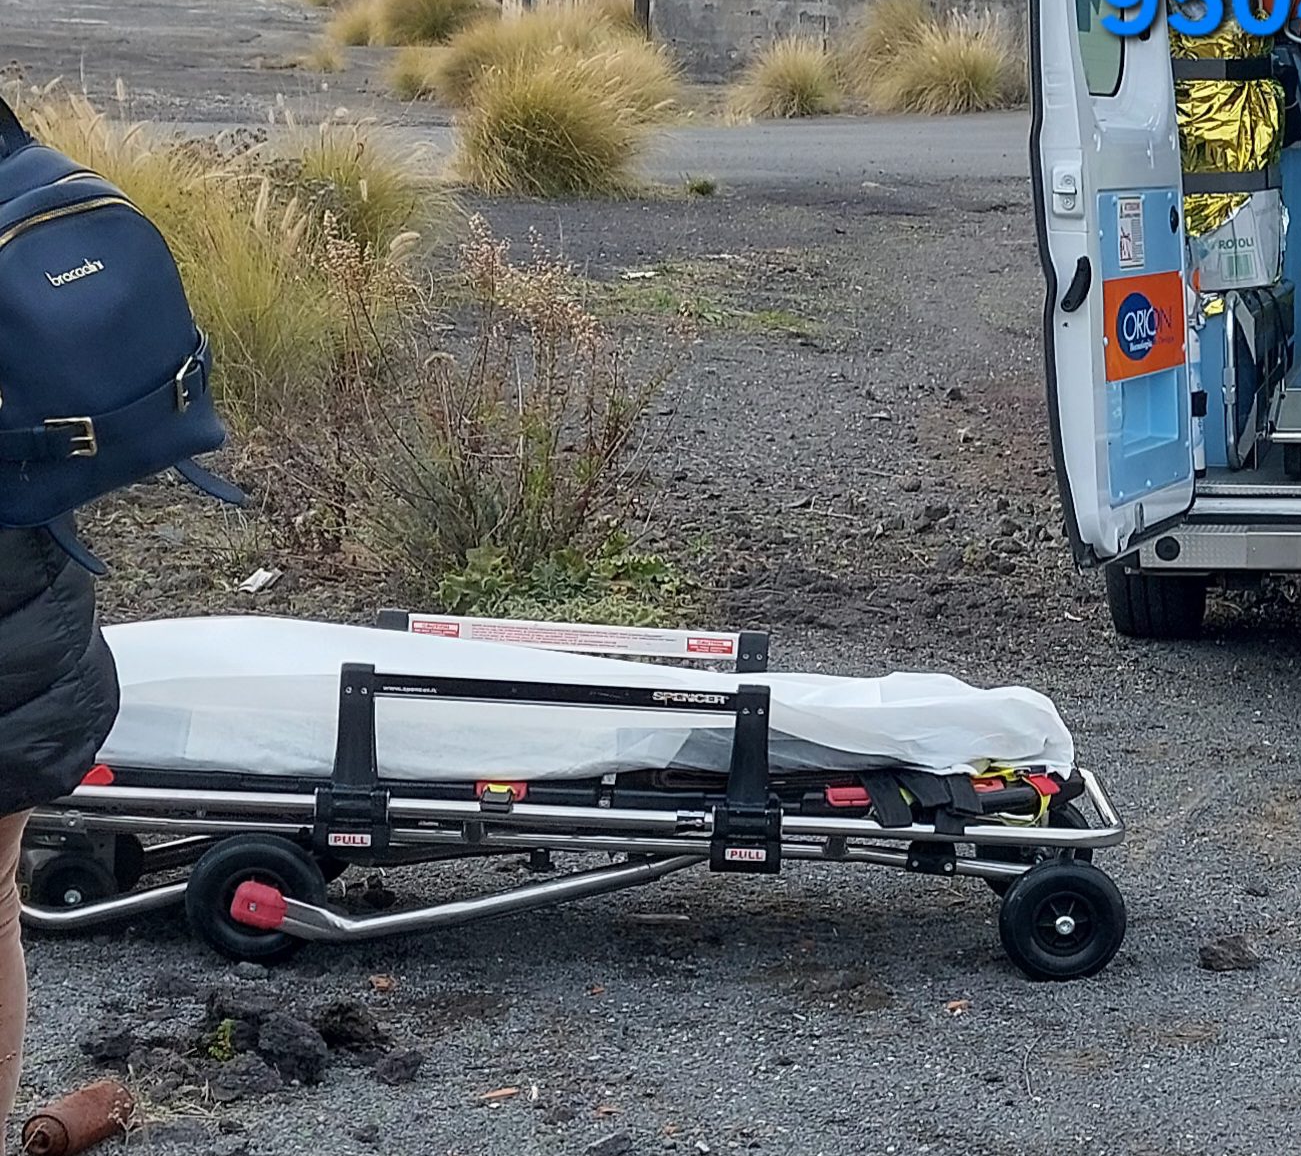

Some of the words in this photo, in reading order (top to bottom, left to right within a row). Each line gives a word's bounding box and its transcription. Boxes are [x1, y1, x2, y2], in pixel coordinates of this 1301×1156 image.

[1122, 306, 1173, 342] ORION
[652, 691, 726, 705] SPENCER
[333, 835, 368, 845] PULL
[730, 850, 764, 860] PULL
